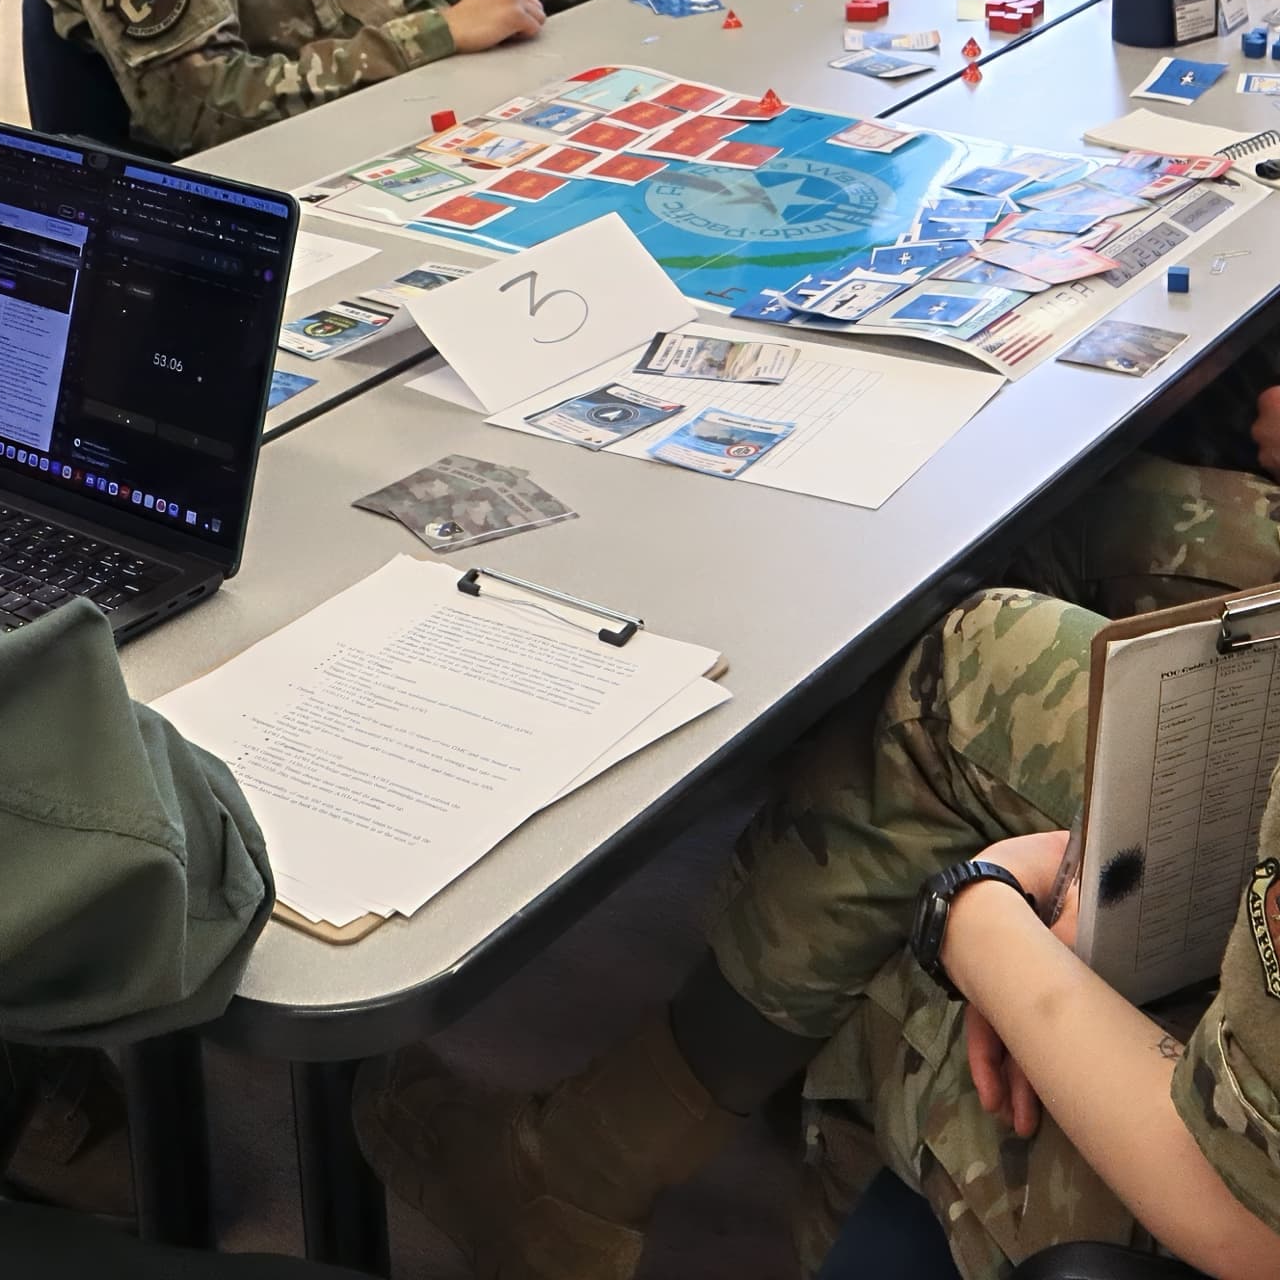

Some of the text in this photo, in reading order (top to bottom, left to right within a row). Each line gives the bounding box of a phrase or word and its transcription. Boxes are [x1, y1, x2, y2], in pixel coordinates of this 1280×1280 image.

[498, 270, 590, 345] 3
[1039, 281, 1096, 312] USA
[1250, 892, 1267, 933] AIR
